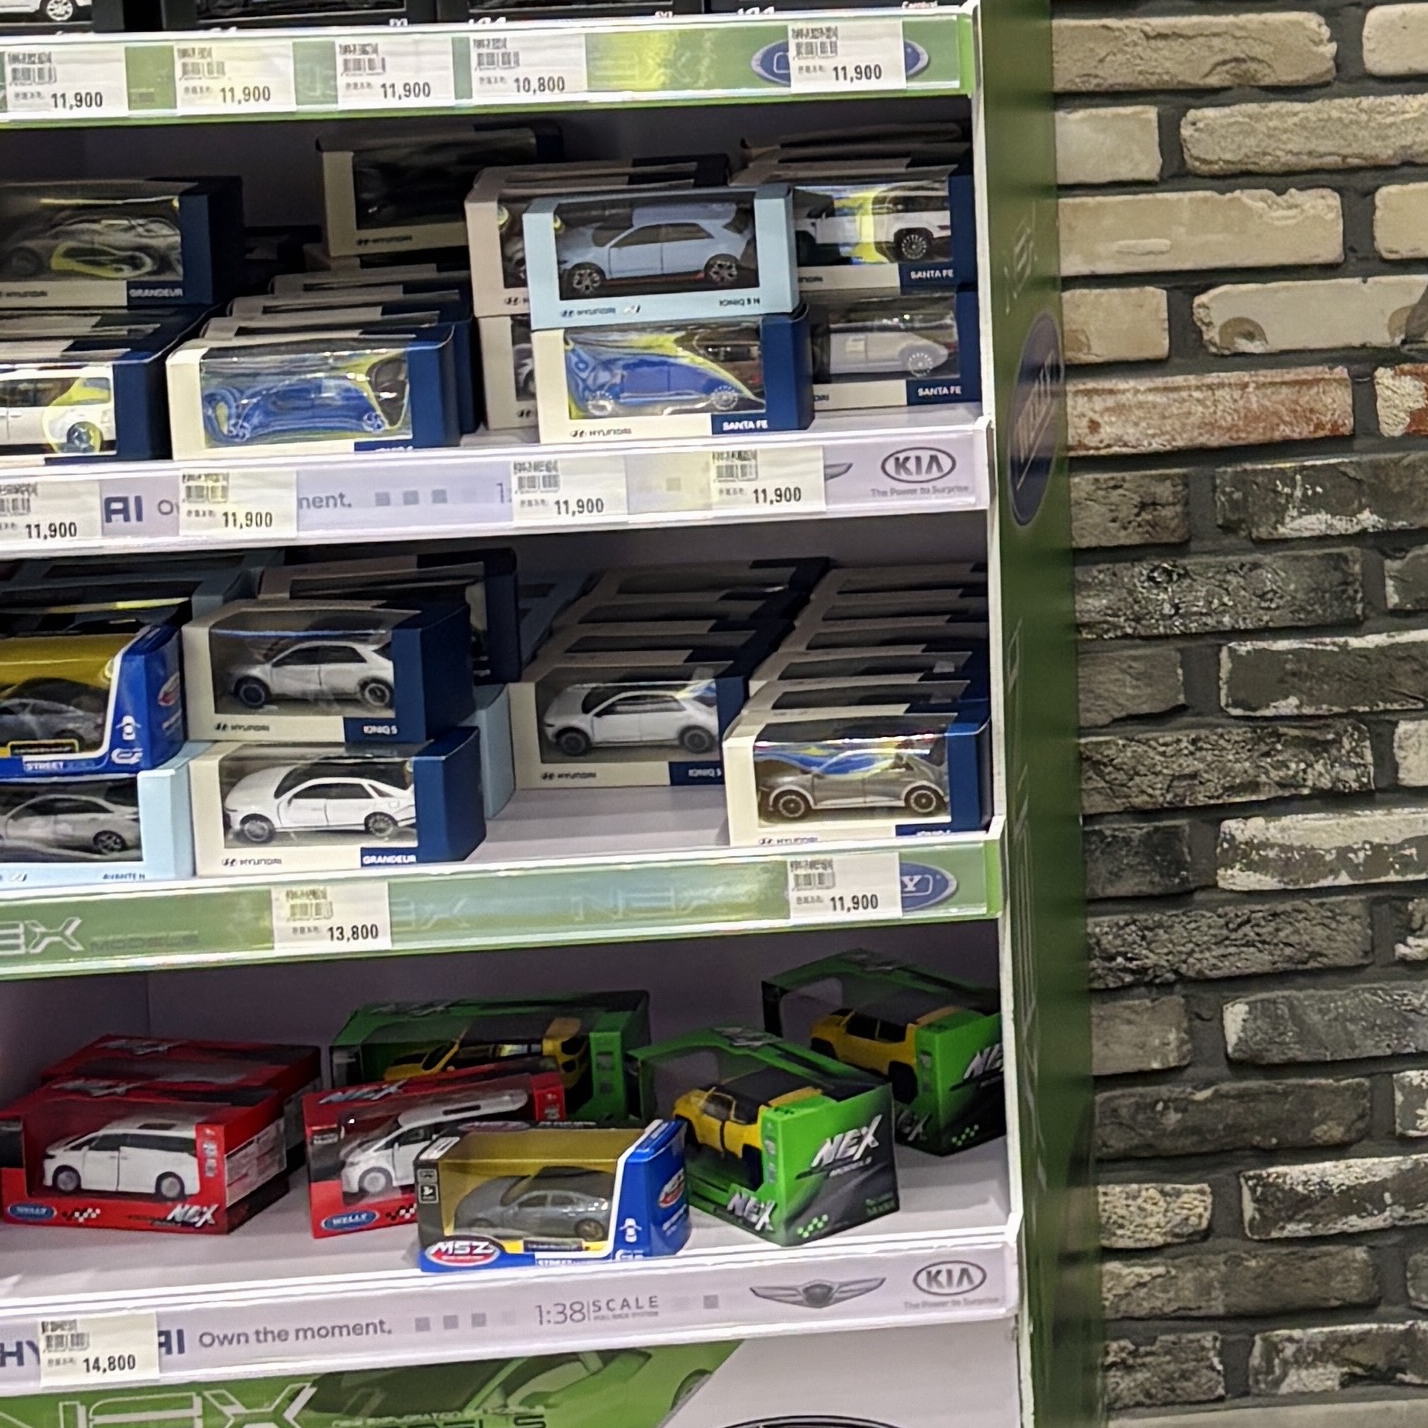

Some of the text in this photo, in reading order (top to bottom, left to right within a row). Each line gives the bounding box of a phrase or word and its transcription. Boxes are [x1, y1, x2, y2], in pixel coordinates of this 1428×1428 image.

[832, 64, 882, 82] 11,900
[380, 81, 431, 100] 11,900
[513, 76, 565, 94] 10,800
[51, 92, 103, 110] 11,900
[219, 85, 271, 105] 11,900
[917, 386, 962, 397] SANTA FE
[722, 419, 768, 431] SANTA FE
[893, 455, 944, 475] KIA
[752, 486, 802, 504] 11,900
[554, 498, 604, 515] 11,900
[222, 510, 272, 528] 11,900
[25, 522, 77, 540] 11,900
[362, 853, 416, 865] GRANDEUR
[830, 894, 879, 912] 11,900
[327, 924, 379, 942] 13,800
[811, 1112, 882, 1169] NEX
[727, 1190, 778, 1233] NEX
[428, 1239, 495, 1258] MSZ
[925, 1270, 975, 1290] KIA
[536, 1295, 659, 1326] 1:38 SCALE
[199, 1331, 249, 1348] Own
[254, 1326, 290, 1345] the
[295, 1318, 392, 1341] moment.
[82, 1354, 136, 1373] 14,800
